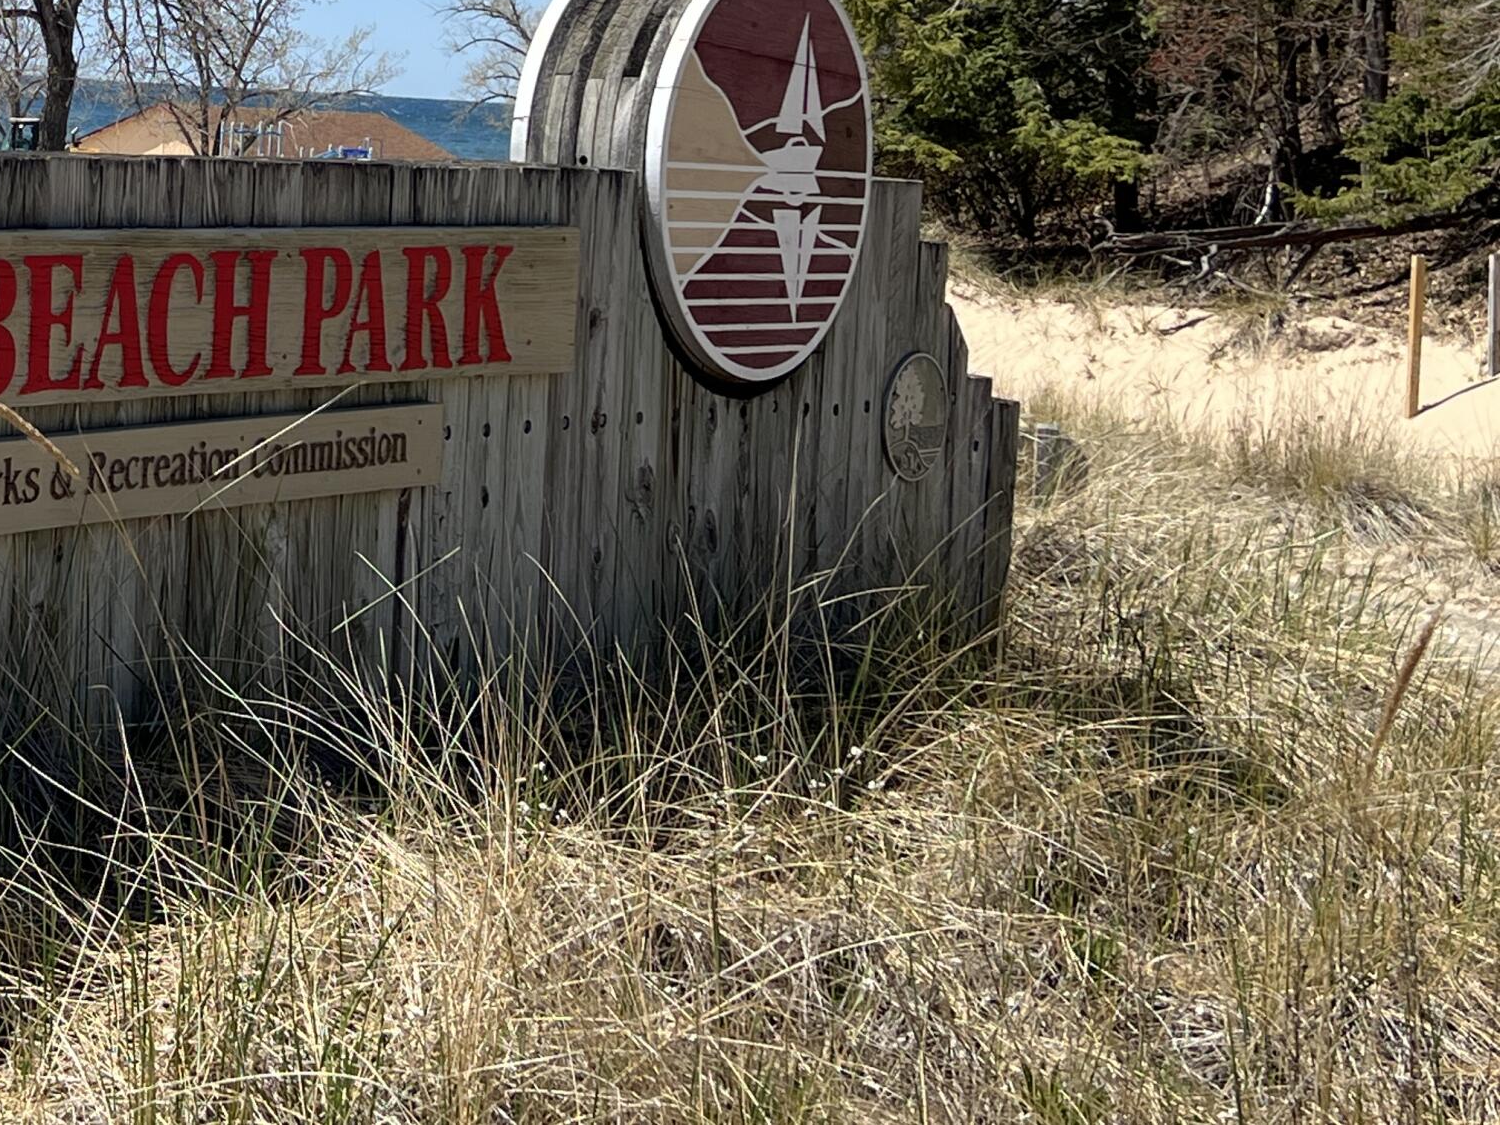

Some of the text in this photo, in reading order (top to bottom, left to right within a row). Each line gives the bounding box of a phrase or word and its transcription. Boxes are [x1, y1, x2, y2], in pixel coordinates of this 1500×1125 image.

[294, 245, 512, 375] PARK
[49, 461, 77, 500] &
[84, 441, 240, 495] Recreation
[250, 426, 408, 479] Commission
